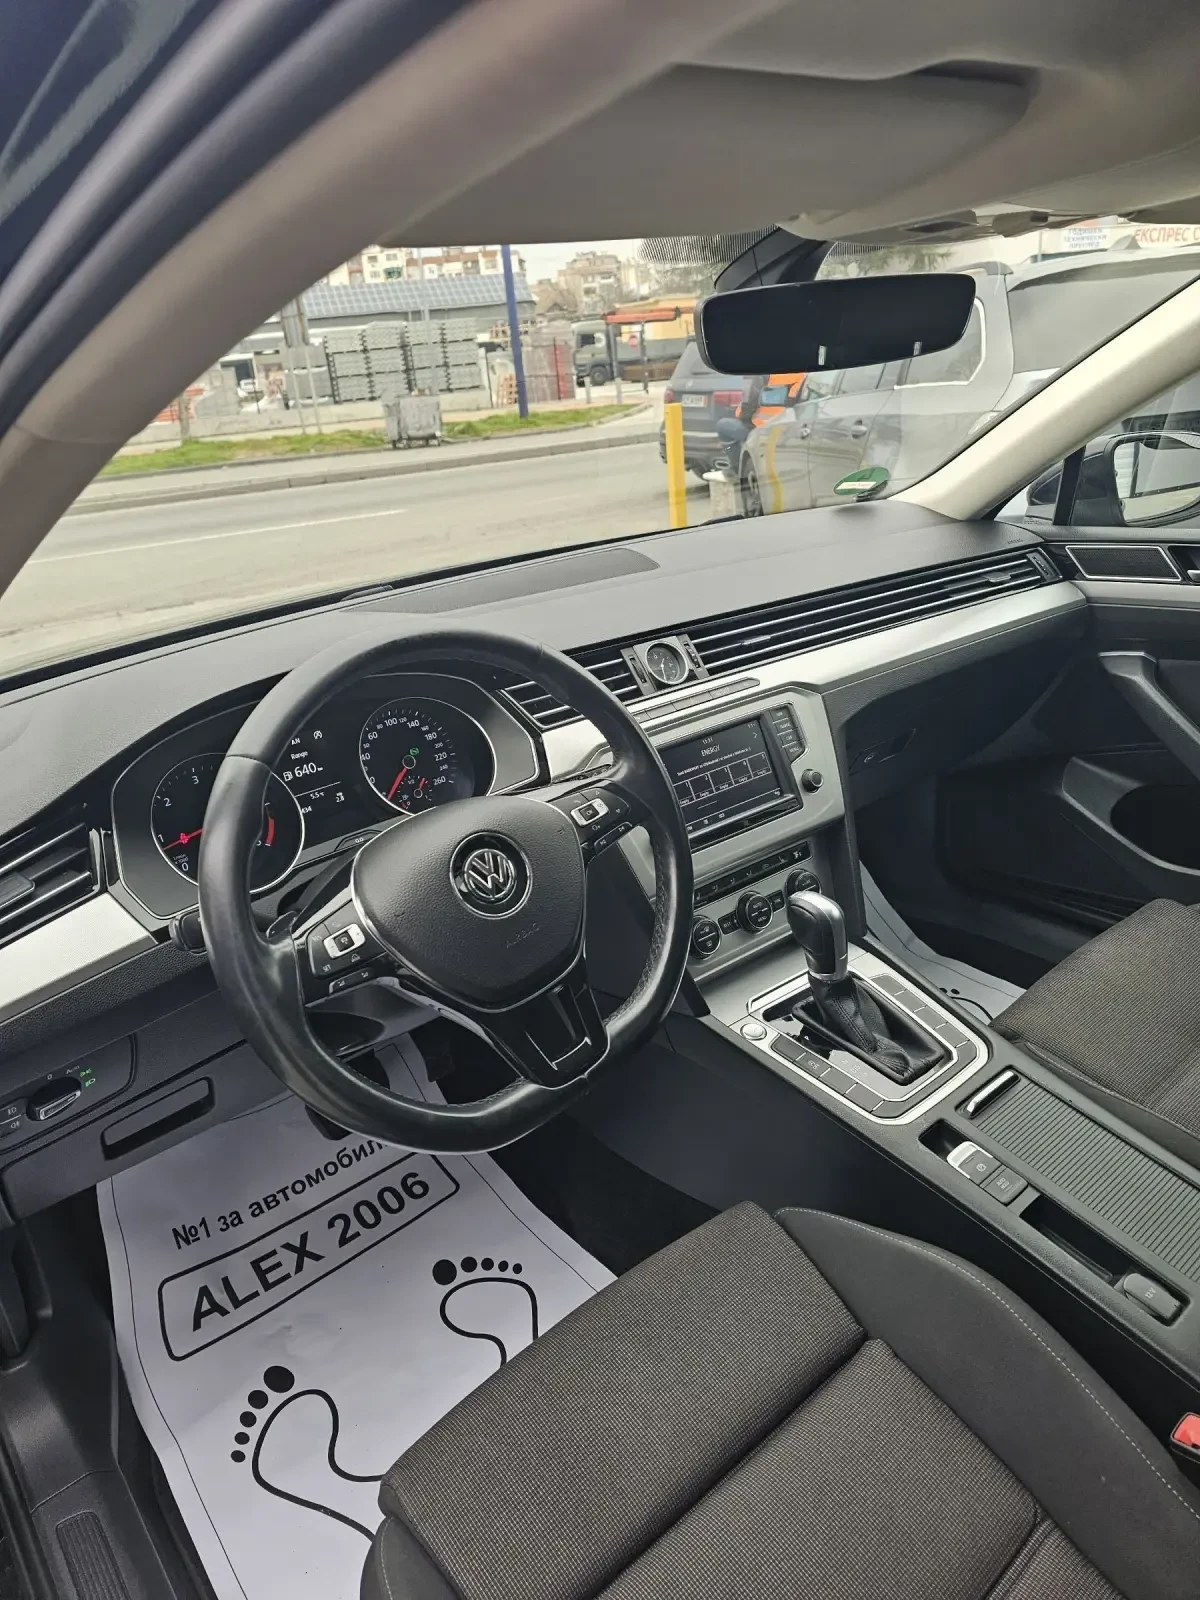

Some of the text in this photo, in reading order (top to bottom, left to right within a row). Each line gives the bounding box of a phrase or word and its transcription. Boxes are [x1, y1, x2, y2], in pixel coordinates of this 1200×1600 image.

[1134, 227, 1190, 243] ЕКСПРЕС
[384, 718, 397, 726] 100
[407, 720, 419, 728] 140
[368, 731, 378, 740] 60
[425, 732, 437, 741] 180
[291, 751, 308, 760] Range
[700, 744, 721, 757] ENERGY
[434, 752, 447, 761] 220
[294, 762, 316, 777] 640
[191, 775, 200, 785] 3
[433, 776, 446, 786] 260
[163, 797, 172, 807] 2
[157, 834, 164, 842] 1
[181, 862, 189, 872] 0
[171, 1138, 390, 1250] №1 за автомобил
[192, 1171, 430, 1332] ALEX 2006
